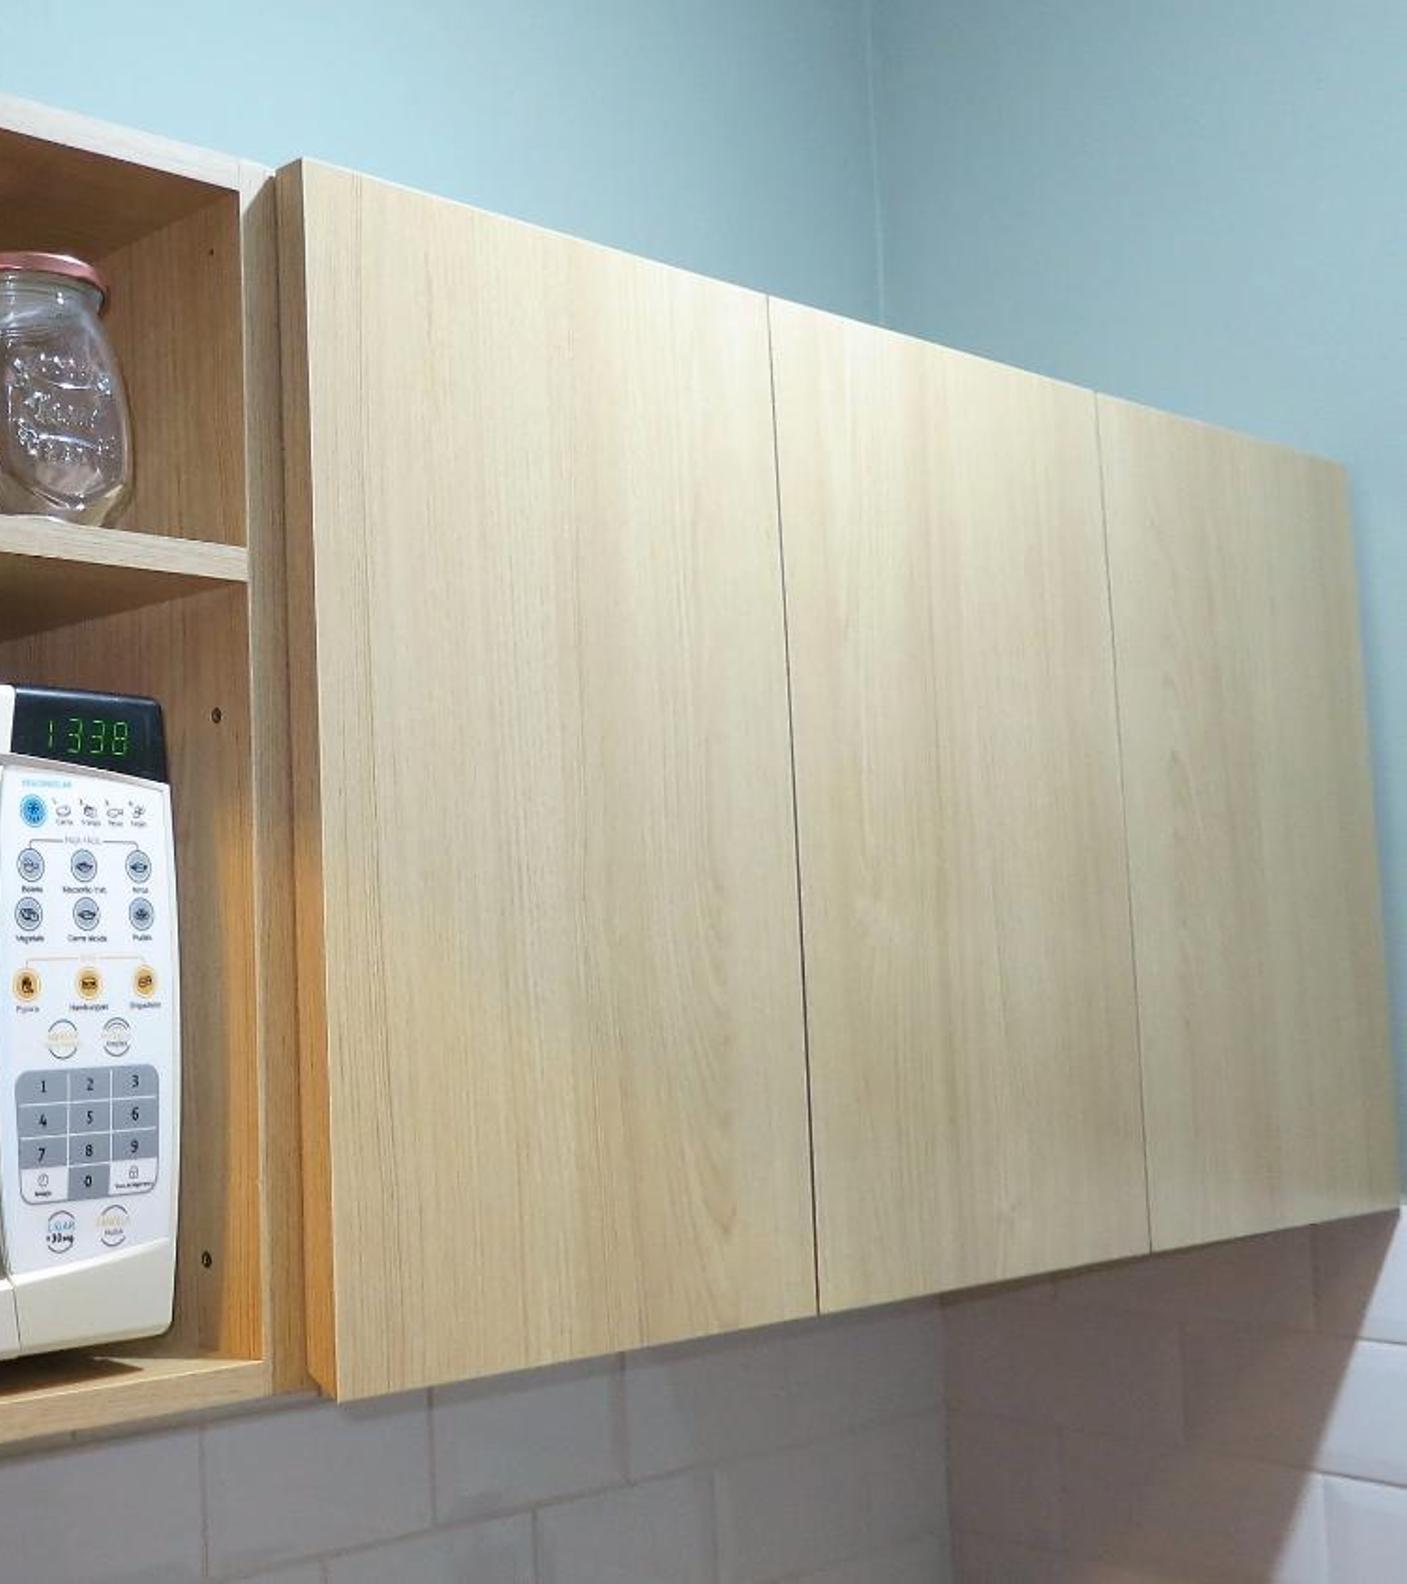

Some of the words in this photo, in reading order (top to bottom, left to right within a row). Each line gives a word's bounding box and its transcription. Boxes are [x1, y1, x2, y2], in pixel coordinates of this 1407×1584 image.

[47, 717, 128, 756] 1338
[41, 1080, 47, 1093] 1
[86, 1078, 94, 1091] 2
[131, 1075, 139, 1088] 3
[87, 1110, 94, 1124] 5
[131, 1106, 140, 1121] 6
[38, 1114, 47, 1127] 4
[85, 1144, 94, 1157] 8
[130, 1140, 139, 1153] 9
[37, 1147, 46, 1162] 7
[84, 1174, 93, 1188] 0
